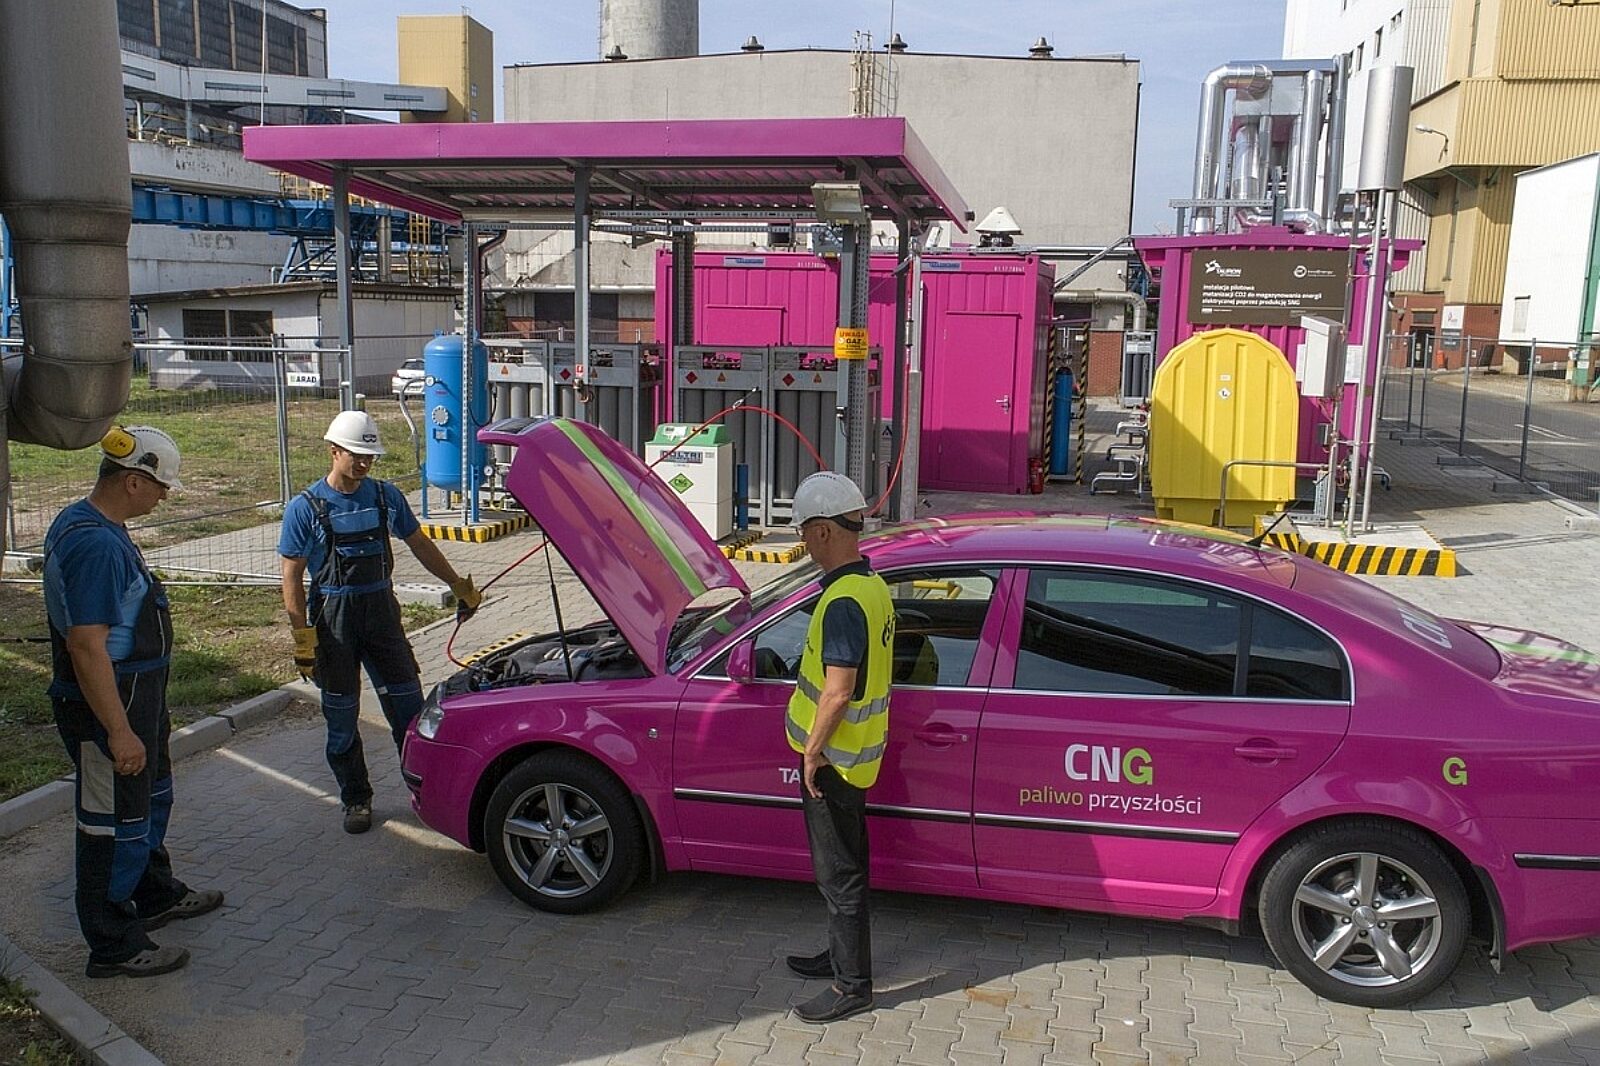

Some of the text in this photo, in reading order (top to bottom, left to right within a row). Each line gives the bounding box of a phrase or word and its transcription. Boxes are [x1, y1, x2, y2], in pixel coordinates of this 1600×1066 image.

[778, 767, 801, 784] TA
[1064, 743, 1154, 786] CNG
[1443, 757, 1468, 786] G
[1019, 785, 1202, 815] paliwo przyszłości
